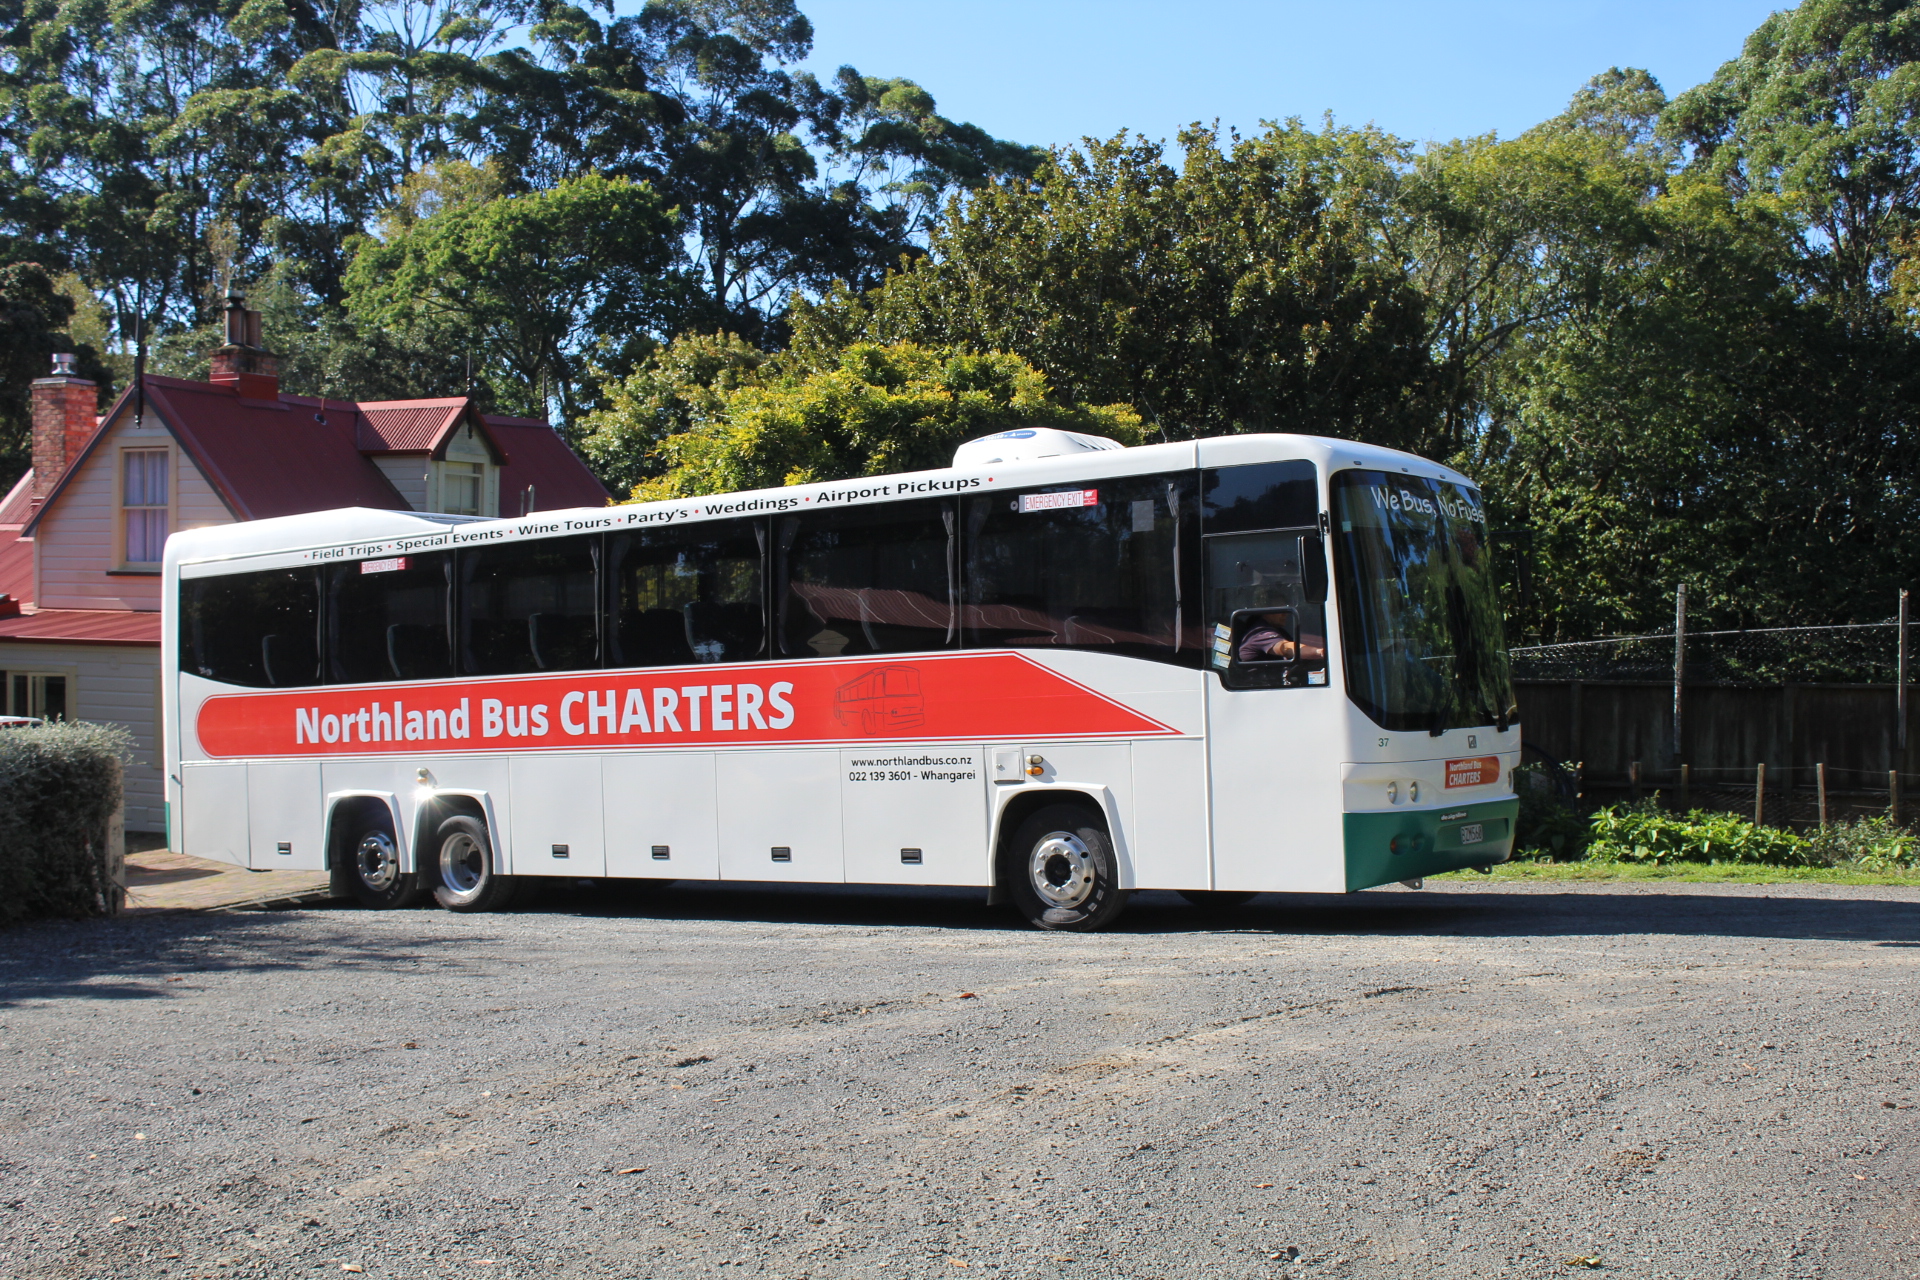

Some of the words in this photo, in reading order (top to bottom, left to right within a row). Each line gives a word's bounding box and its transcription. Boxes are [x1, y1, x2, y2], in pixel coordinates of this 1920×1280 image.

[1026, 494, 1065, 509] EMERGENCY
[1068, 493, 1081, 505] EXIT
[1370, 486, 1399, 510] We
[1400, 490, 1437, 515] Bus,
[1436, 495, 1456, 517] No
[1457, 500, 1485, 524] Fuss
[312, 547, 345, 560] Field
[349, 544, 383, 557] Trips
[396, 535, 448, 551] Special
[454, 529, 504, 544] Events
[518, 523, 560, 536] Wine
[564, 518, 612, 531] Tours
[705, 495, 798, 517] Weddings
[816, 486, 890, 505] Airport
[897, 476, 981, 497] Pickups
[296, 697, 470, 745] Northland
[482, 697, 549, 738] Bus
[560, 682, 795, 736] CHARTERS
[1378, 738, 1389, 747] 37
[851, 756, 972, 766] www.northlandbus.co.nz
[1449, 761, 1473, 771] Northland
[1473, 760, 1481, 769] Bus
[849, 772, 867, 781] 022
[869, 771, 886, 781] 139
[888, 771, 911, 781] 3601
[921, 770, 976, 782] Whangarei
[1449, 771, 1481, 786] CHARTERS
